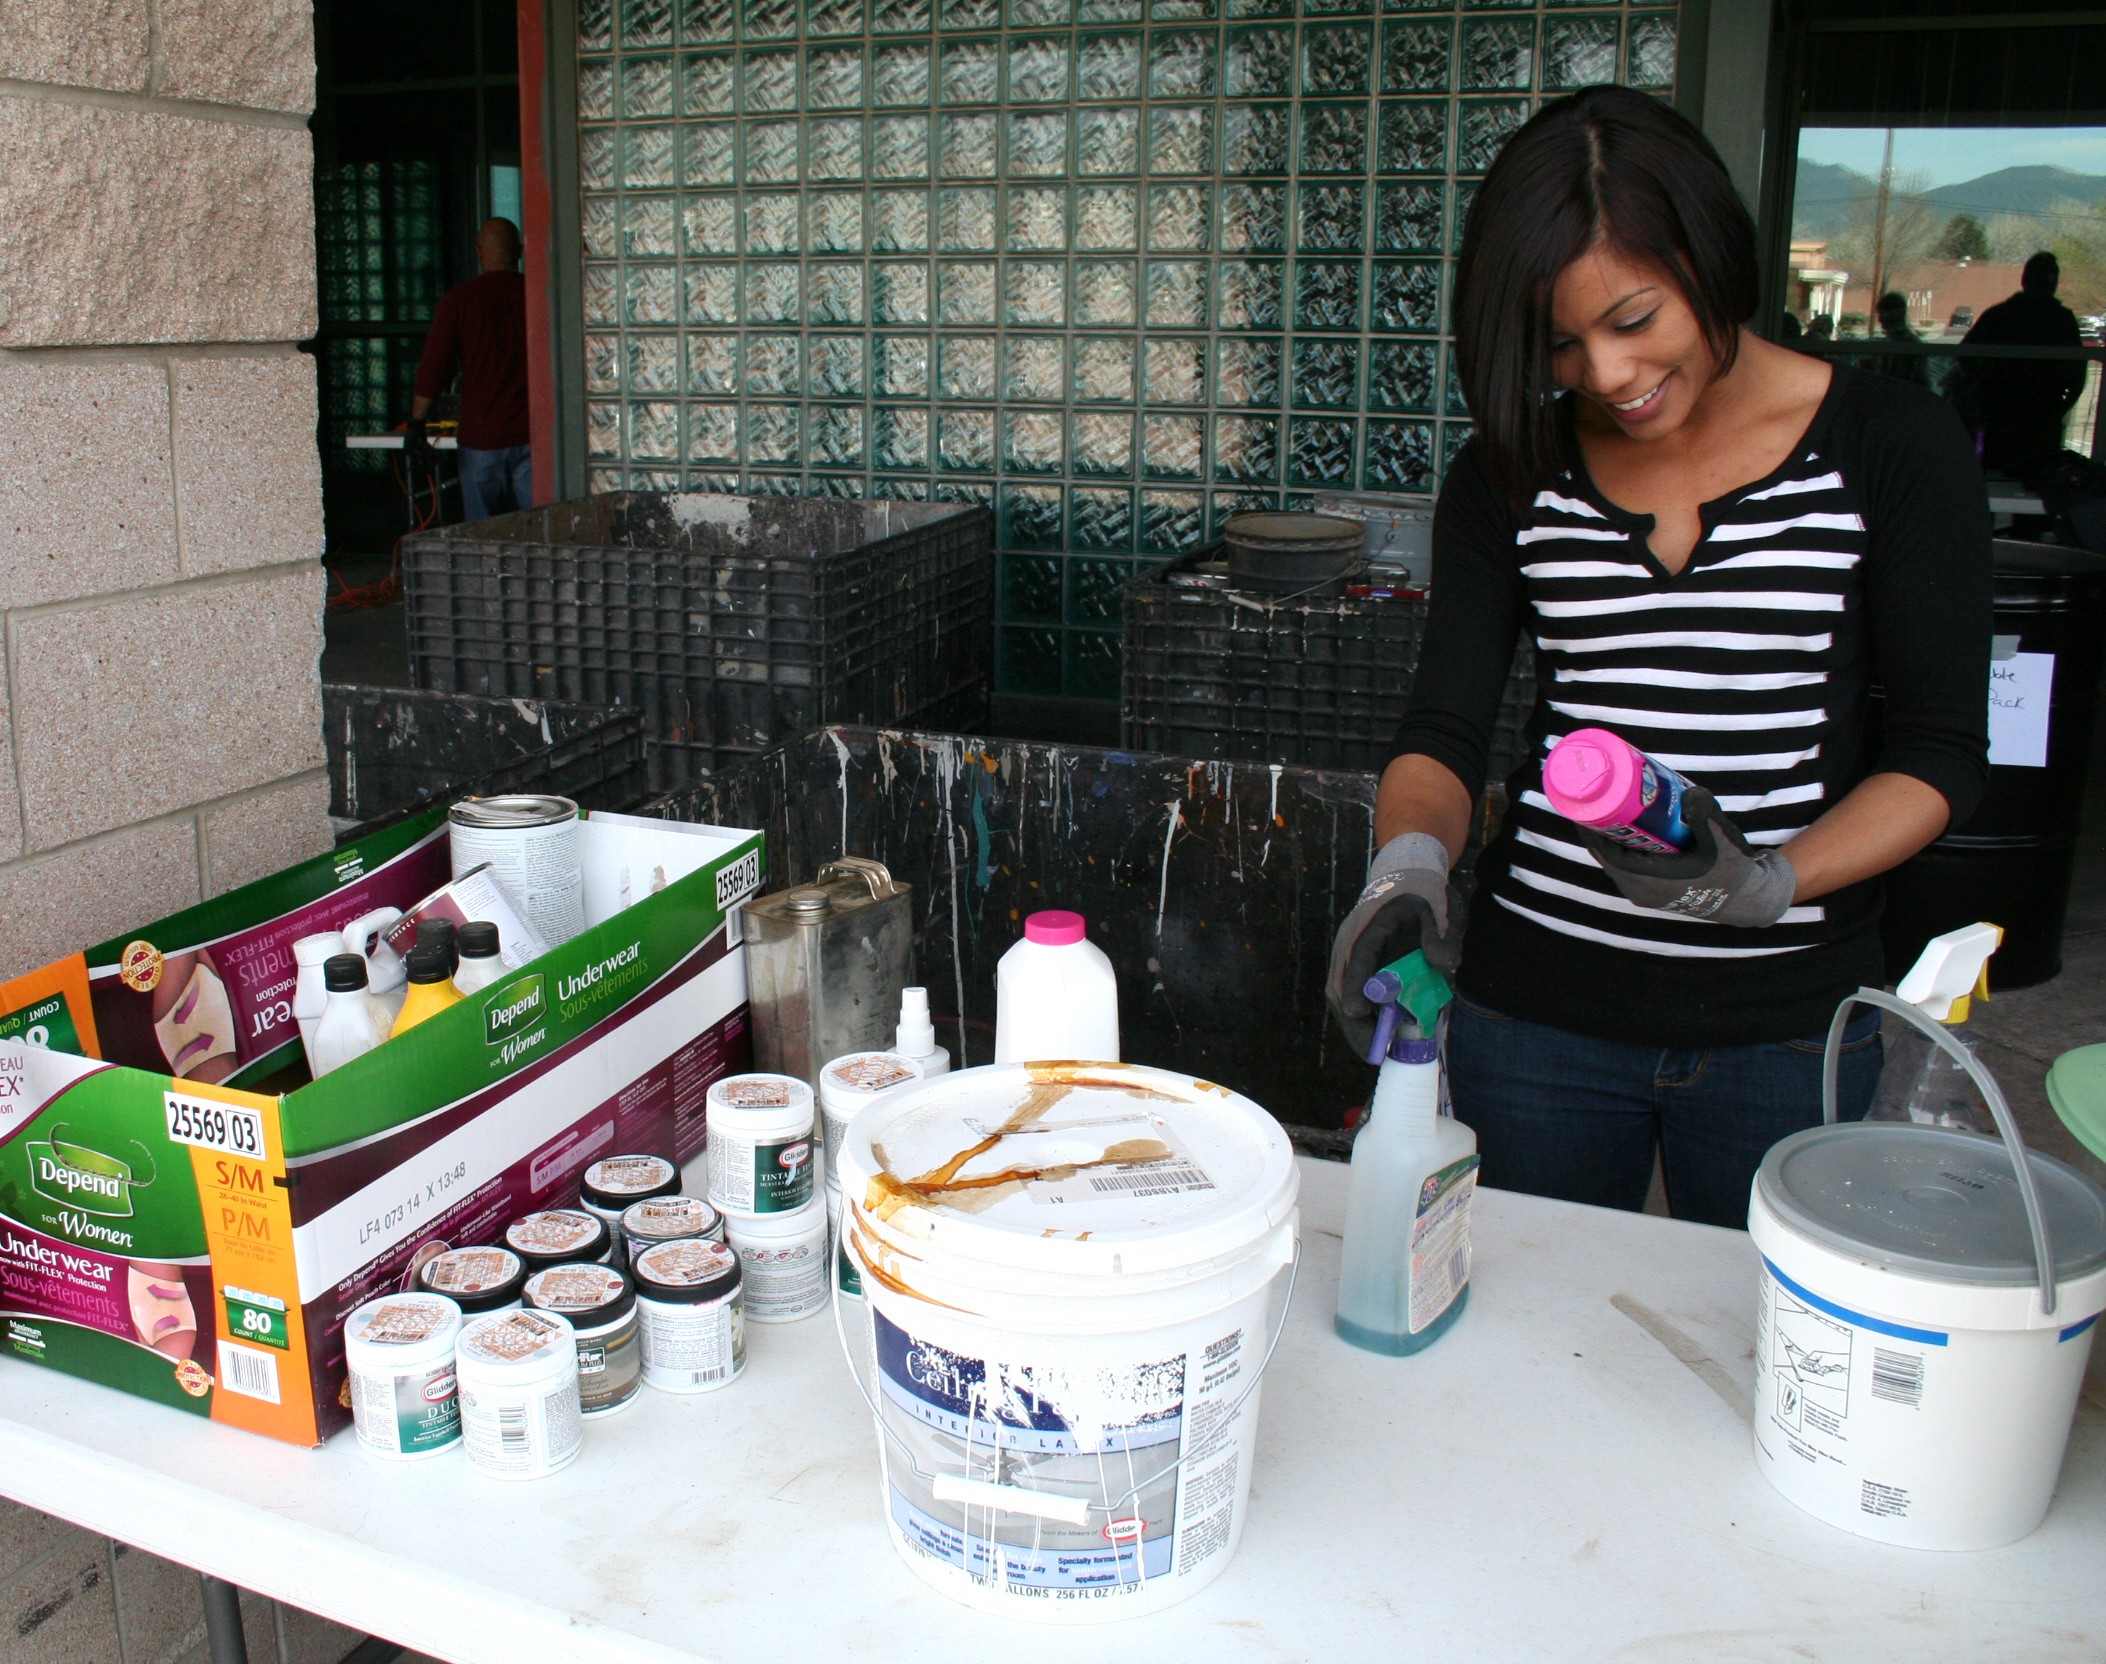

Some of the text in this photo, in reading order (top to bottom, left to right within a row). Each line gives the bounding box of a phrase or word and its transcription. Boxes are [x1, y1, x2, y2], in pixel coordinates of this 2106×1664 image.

[718, 856, 756, 904] 25569 03
[275, 916, 313, 940] protection
[314, 910, 329, 922] avec
[557, 940, 642, 1001] Underwear
[256, 977, 297, 1002] rotection
[560, 958, 648, 1023] Sous-vêtements
[29, 1001, 59, 1023] COUNT
[491, 986, 540, 1030] Depend
[490, 1028, 546, 1068] FOR Women
[169, 1101, 256, 1152] 25569 03
[39, 1157, 121, 1198] Depend
[216, 1160, 264, 1193] S/M
[249, 1199, 267, 1209] Waist
[359, 1161, 466, 1245] LF4 073 14 X 13:48
[41, 1211, 132, 1248] FOR Women
[222, 1207, 270, 1240] P/M
[338, 1279, 353, 1292] Only
[379, 1251, 396, 1265] Gives
[396, 1243, 407, 1253] You
[406, 1236, 416, 1246] the
[416, 1215, 447, 1238] Confidence
[447, 1209, 454, 1217] of
[476, 1176, 503, 1197] Protection
[0, 1232, 113, 1281] Underwear
[0, 1265, 119, 1317] Sous-vêtements
[68, 1273, 107, 1292] Protection
[365, 1288, 379, 1301] Peach
[378, 1279, 391, 1291] Color
[53, 1305, 87, 1319] protection
[243, 1308, 272, 1334] 80
[10, 1319, 42, 1337] Maximum
[234, 1327, 253, 1338] COUNT
[1205, 1328, 1242, 1354] QUESTIONS?
[1204, 1366, 1227, 1383] Maximum
[422, 1415, 449, 1428] TINTABLE
[1107, 1525, 1138, 1536] Glidde
[1007, 1561, 1019, 1569] the
[1058, 1557, 1091, 1565] Specially
[1007, 1571, 1025, 1579] room
[1075, 1573, 1115, 1583] application
[1005, 1584, 1049, 1599] ALLONS
[1056, 1589, 1075, 1599] 256
[1079, 1589, 1090, 1599] FL
[1094, 1588, 1109, 1598] OZ
